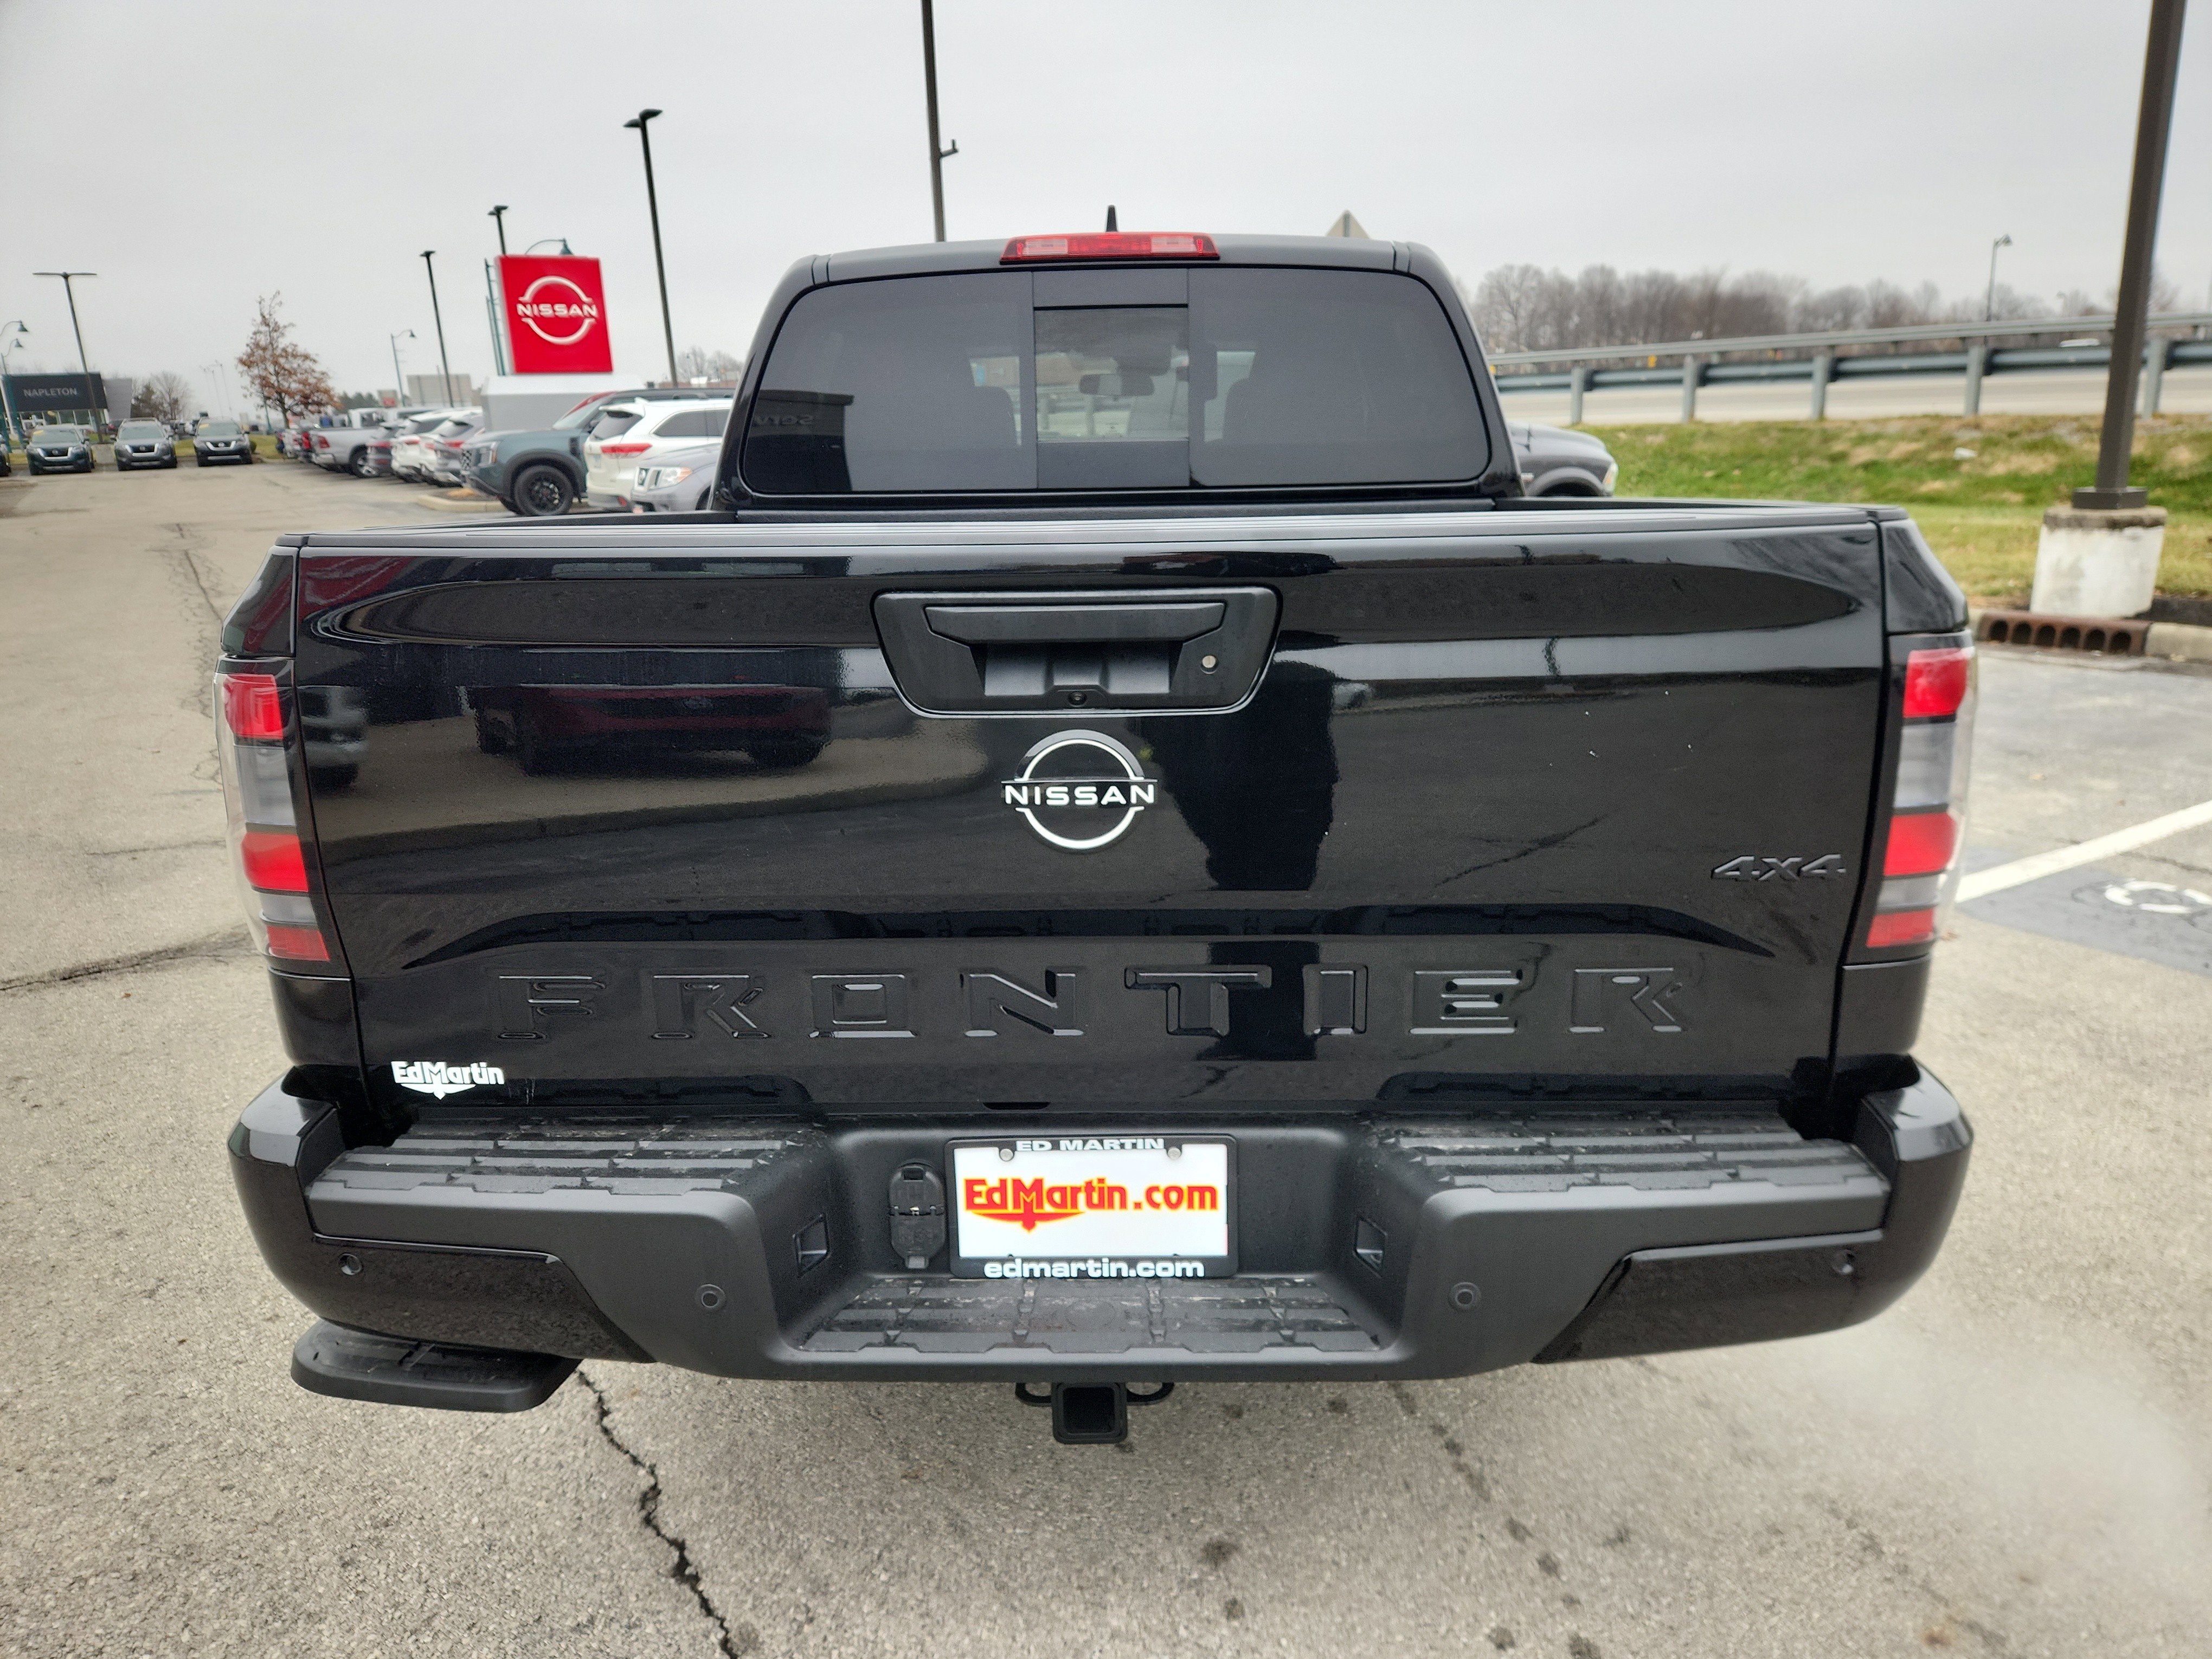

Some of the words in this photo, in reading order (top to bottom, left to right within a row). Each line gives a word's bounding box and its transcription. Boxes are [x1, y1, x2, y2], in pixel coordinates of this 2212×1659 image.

[516, 303, 597, 318] NISSAN
[23, 388, 78, 397] NAPLETON
[1005, 784, 1154, 806] NISSAN
[496, 966, 1683, 1038] FRONTIER
[1016, 1140, 1052, 1151] ED
[1059, 1139, 1165, 1150] MARTIN
[984, 1258, 1205, 1279] edmartin.com
